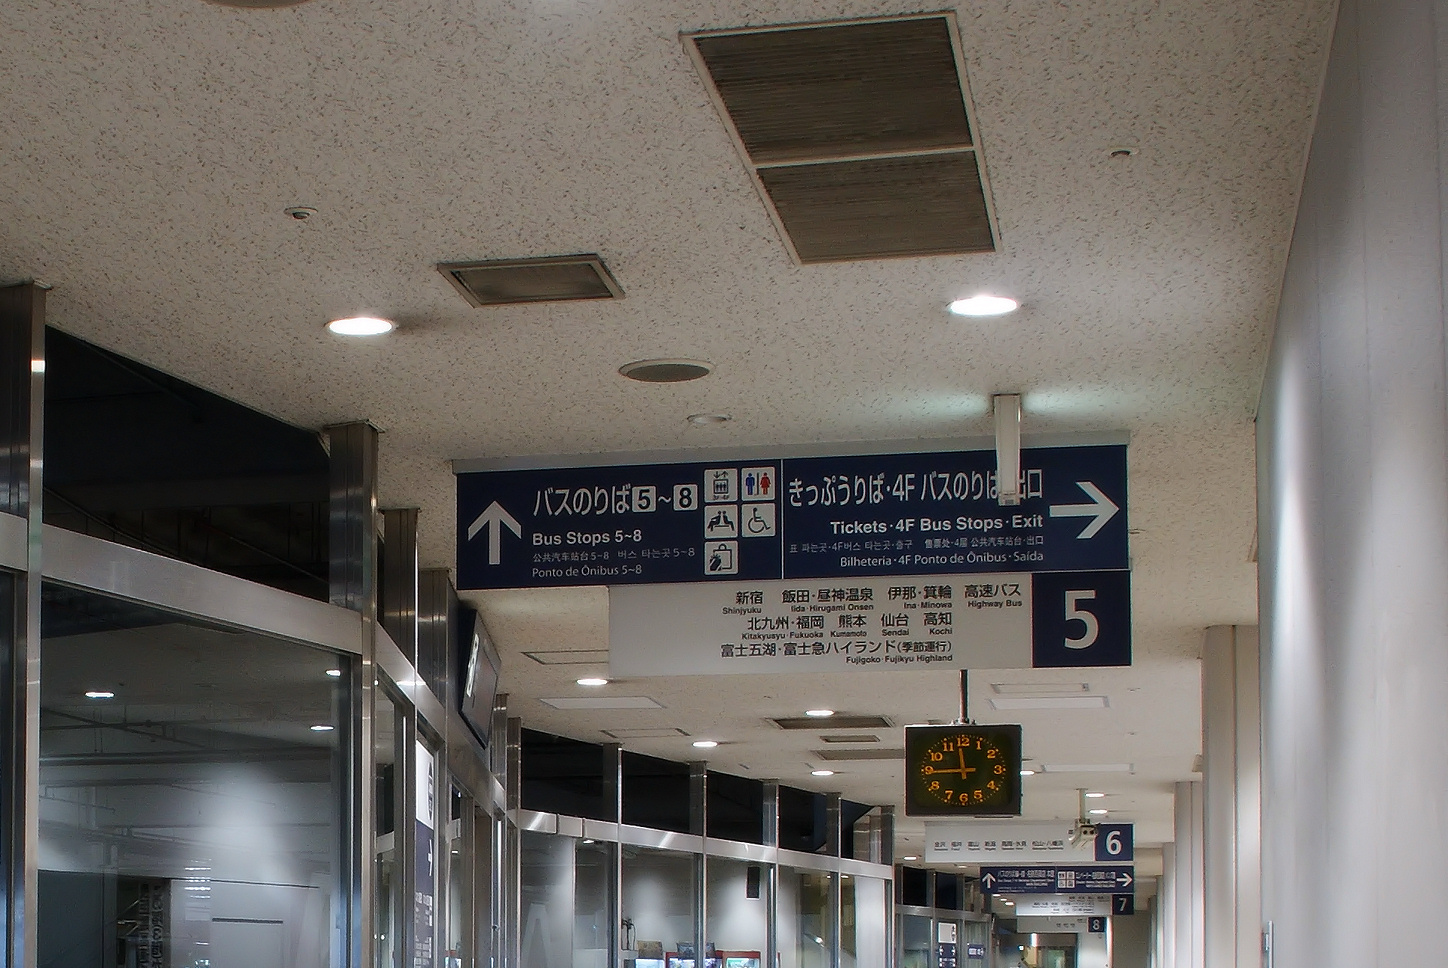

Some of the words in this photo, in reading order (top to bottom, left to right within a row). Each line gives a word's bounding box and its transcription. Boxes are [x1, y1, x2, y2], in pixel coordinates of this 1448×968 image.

[920, 517, 952, 532] Bus
[532, 532, 562, 546] Bus
[566, 530, 611, 546] Stops
[615, 529, 643, 543] 5~8
[617, 549, 638, 560] 버스
[914, 554, 948, 566] Ponto
[949, 552, 965, 564] de
[532, 567, 564, 578] Ponto
[565, 566, 579, 576] de
[581, 564, 619, 577] Ônibus
[736, 590, 764, 605] 新宿
[964, 583, 1022, 599] 高速バス
[722, 606, 762, 616] Shinjyuku
[848, 603, 875, 612] Onsen
[967, 600, 1003, 610] Highway
[1006, 599, 1023, 608] Bus
[838, 614, 868, 629] 熊本
[880, 612, 910, 628] 仙台
[923, 612, 953, 627] 高知
[1064, 589, 1100, 650] 5
[830, 630, 868, 638] Kumamoto
[881, 628, 910, 637] Sendai
[929, 627, 953, 636] Kochi
[916, 654, 953, 664] Highland
[943, 741, 954, 751] 11
[956, 737, 970, 747] 12
[976, 740, 982, 750] 1
[930, 751, 943, 762] 10
[986, 749, 996, 759] 2
[924, 765, 934, 775] 9
[993, 764, 1003, 775] 3
[931, 780, 940, 791] 8
[986, 780, 996, 790] 4
[944, 790, 954, 800] 7
[958, 793, 969, 803] 6
[973, 789, 983, 800] 5
[1105, 830, 1122, 855] 6
[1118, 897, 1127, 912] 7
[1092, 919, 1100, 930] 8
